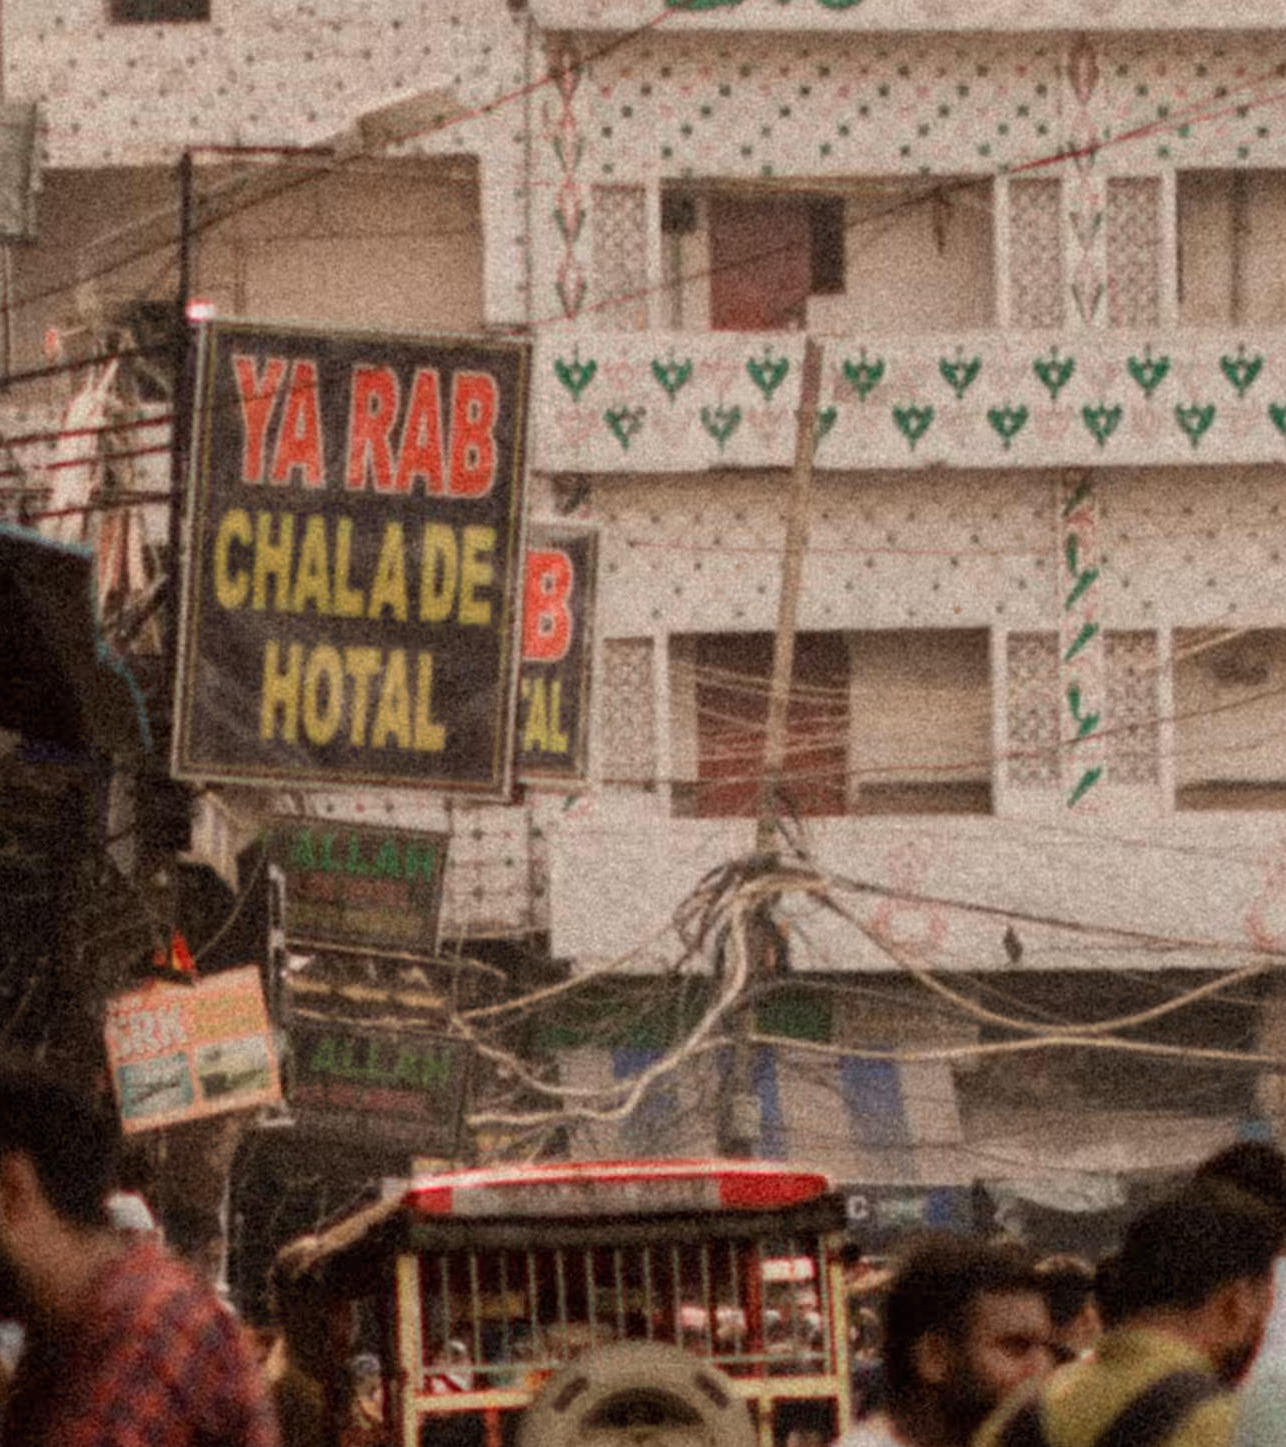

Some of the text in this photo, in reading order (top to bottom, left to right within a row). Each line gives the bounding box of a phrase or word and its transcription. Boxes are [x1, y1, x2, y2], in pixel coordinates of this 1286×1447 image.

[233, 354, 500, 498] YA RAB
[260, 639, 447, 752] HOTAL
